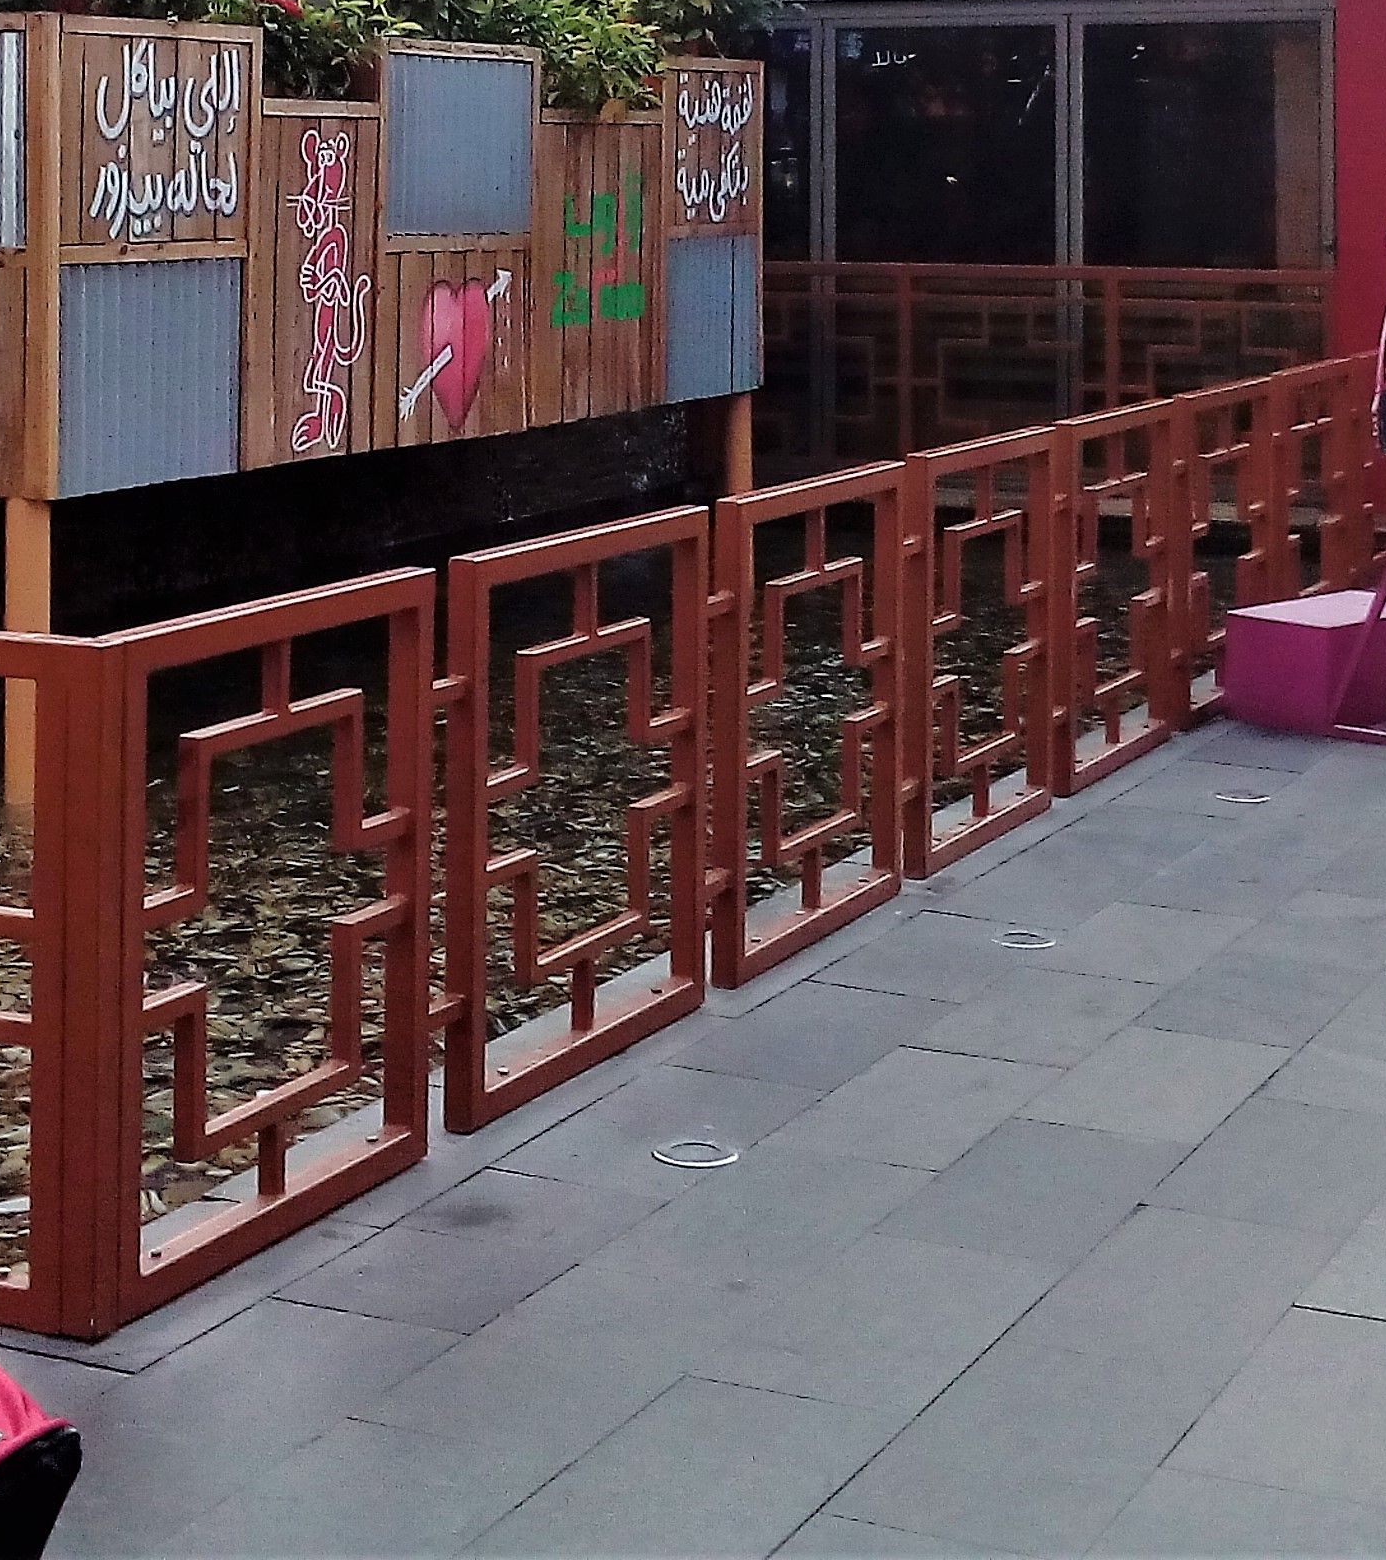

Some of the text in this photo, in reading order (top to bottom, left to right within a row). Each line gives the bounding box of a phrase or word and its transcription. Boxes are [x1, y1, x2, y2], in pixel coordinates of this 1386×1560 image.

[679, 73, 753, 145] لقمة هنية
[88, 144, 164, 240] بيزور
